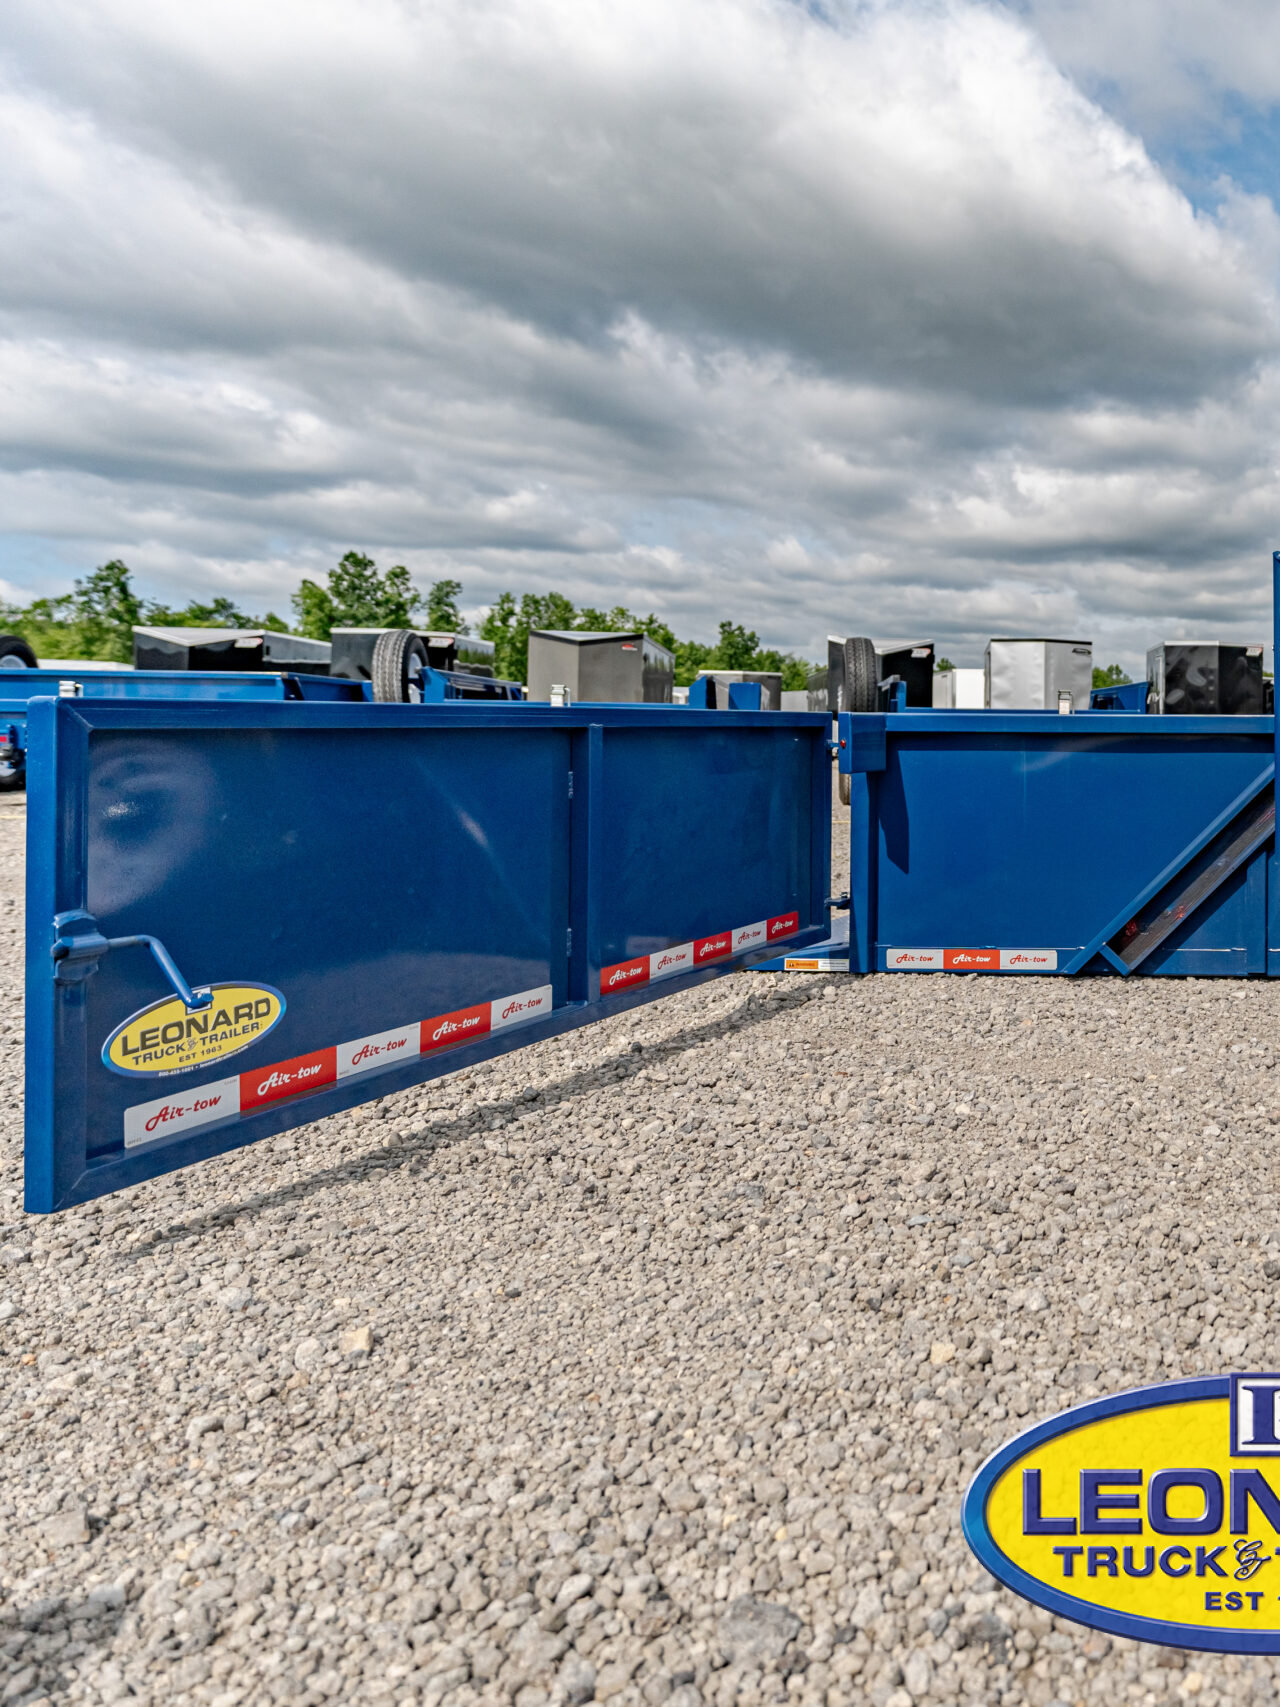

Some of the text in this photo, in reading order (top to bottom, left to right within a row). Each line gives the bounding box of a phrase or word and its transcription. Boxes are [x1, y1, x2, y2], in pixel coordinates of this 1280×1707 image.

[608, 919, 794, 986] Air-tow Air-tow Air-tow Air-tow Air-tow
[896, 953, 1048, 965] Air-tow Air-tow Air-tow
[121, 997, 271, 1057] LEONARD
[132, 1042, 186, 1066] TRUCK
[200, 1021, 260, 1046] TRAILER
[145, 997, 543, 1132] Air-tow Air-tow Air-tow Air-tow Air-tow
[178, 1044, 222, 1063] EST 1963
